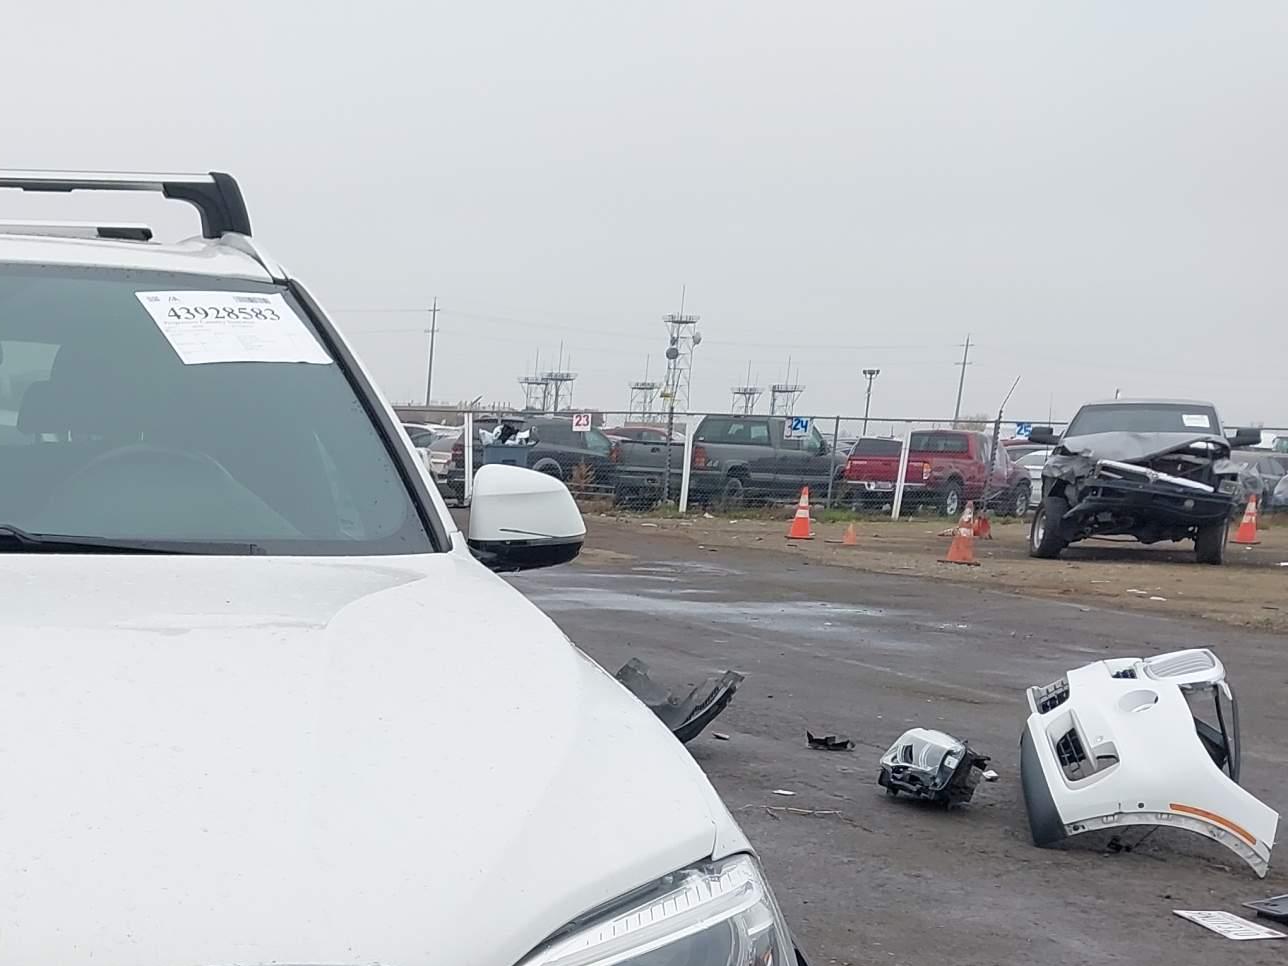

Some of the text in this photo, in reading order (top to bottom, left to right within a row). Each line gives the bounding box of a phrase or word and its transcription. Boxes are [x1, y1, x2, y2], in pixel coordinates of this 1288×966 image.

[168, 306, 280, 321] 43928583
[575, 414, 590, 426] 23
[792, 418, 809, 433] 24
[1016, 422, 1032, 437] 25
